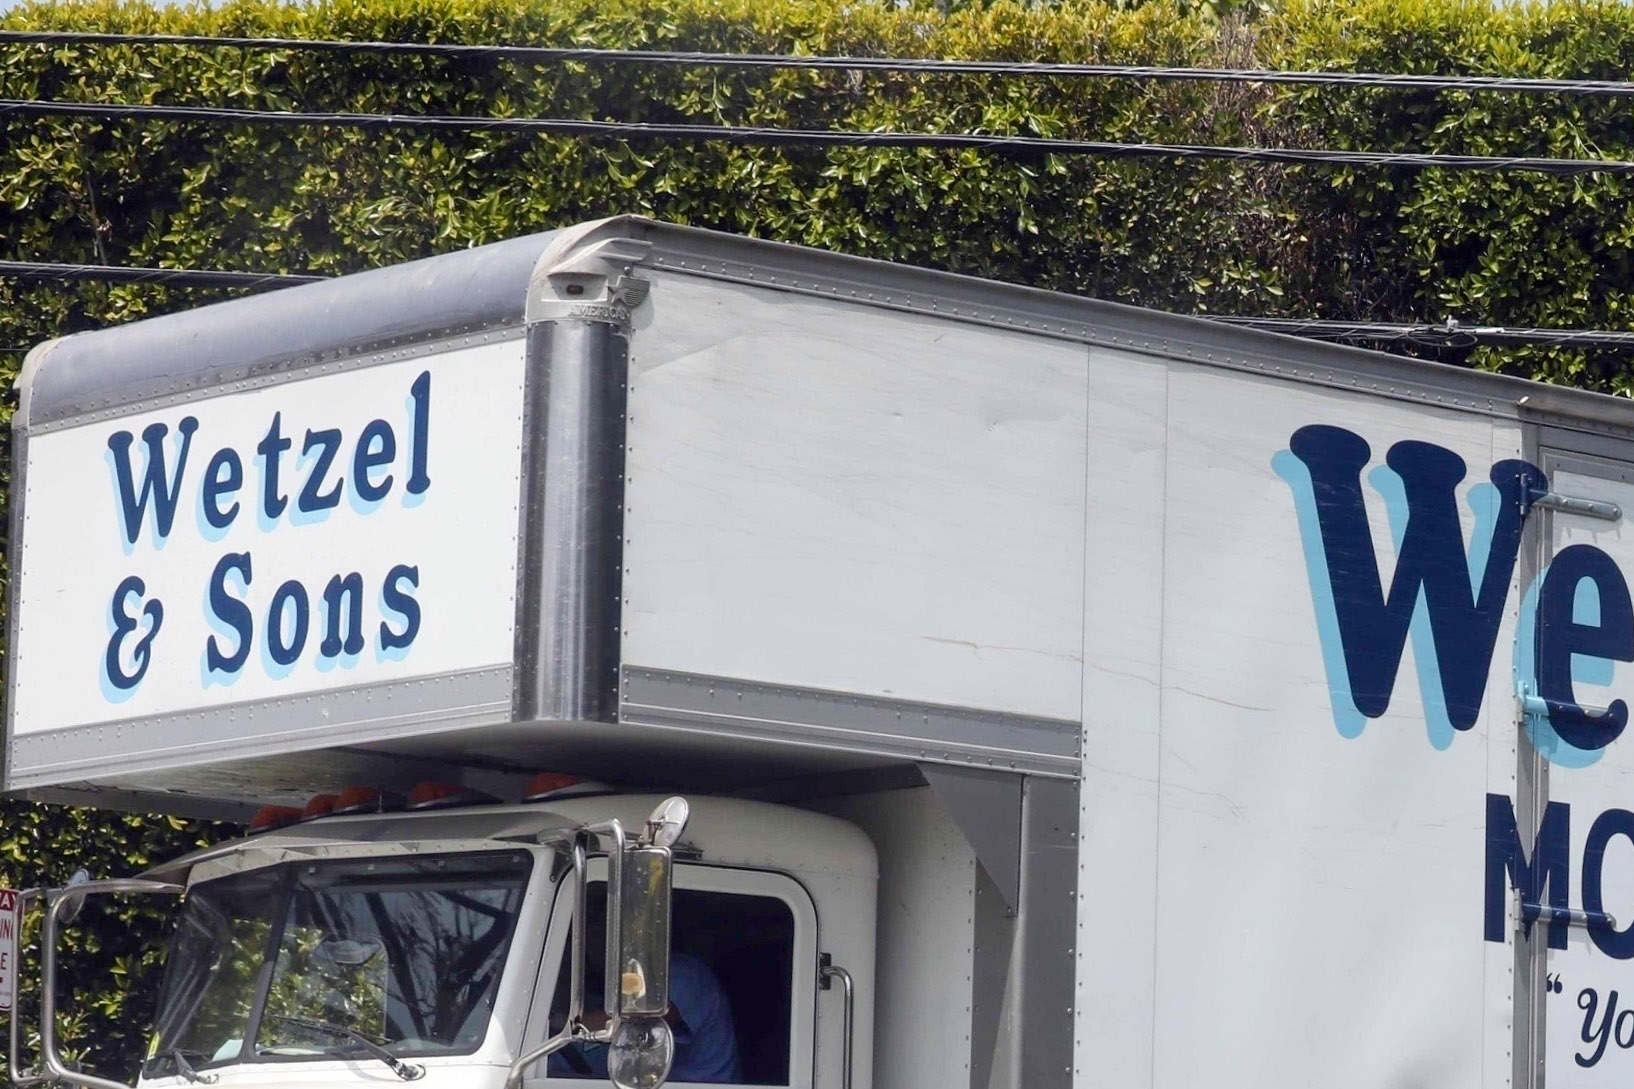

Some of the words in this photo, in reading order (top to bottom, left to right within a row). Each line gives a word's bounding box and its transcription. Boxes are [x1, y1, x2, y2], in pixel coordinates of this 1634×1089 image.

[104, 370, 431, 555] Wetzel
[100, 575, 164, 702] &
[200, 551, 421, 689] Sons
